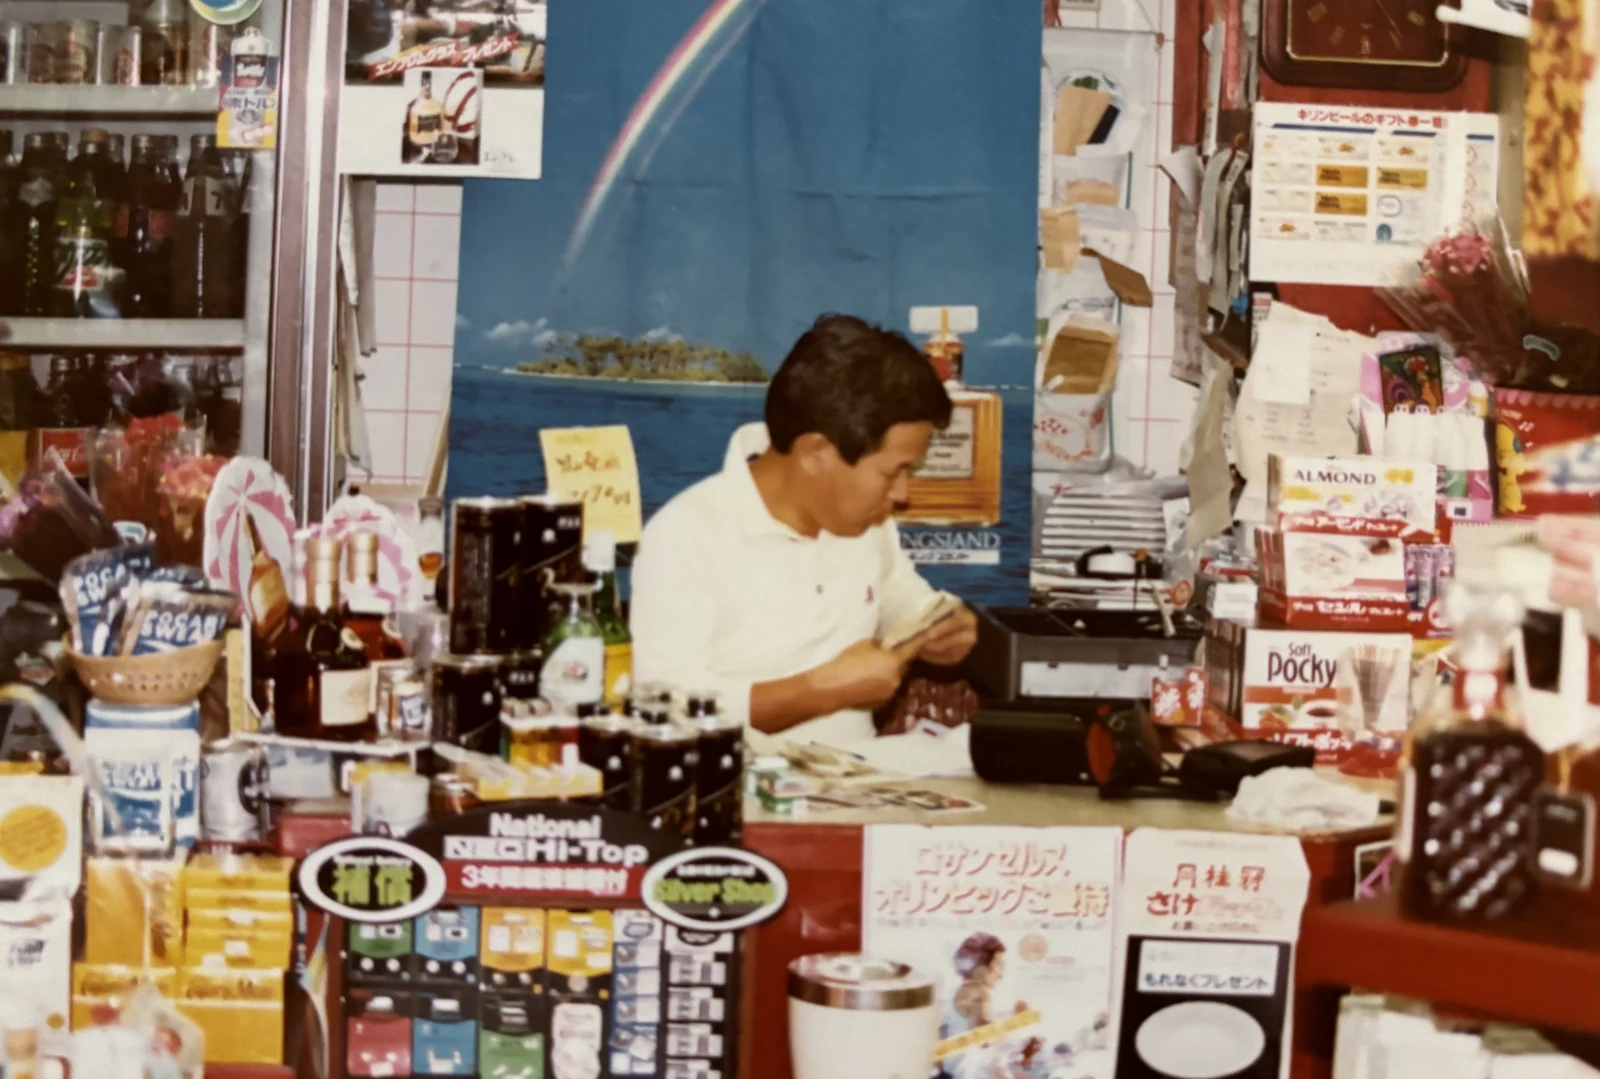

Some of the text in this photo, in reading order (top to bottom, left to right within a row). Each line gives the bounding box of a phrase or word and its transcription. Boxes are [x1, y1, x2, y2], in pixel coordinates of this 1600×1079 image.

[1294, 469, 1377, 485] ALMOND
[901, 531, 1000, 549] NGSLAND
[1288, 642, 1313, 657] Soft
[489, 811, 602, 838] National
[1144, 972, 1270, 991] もれなくプレゼント
